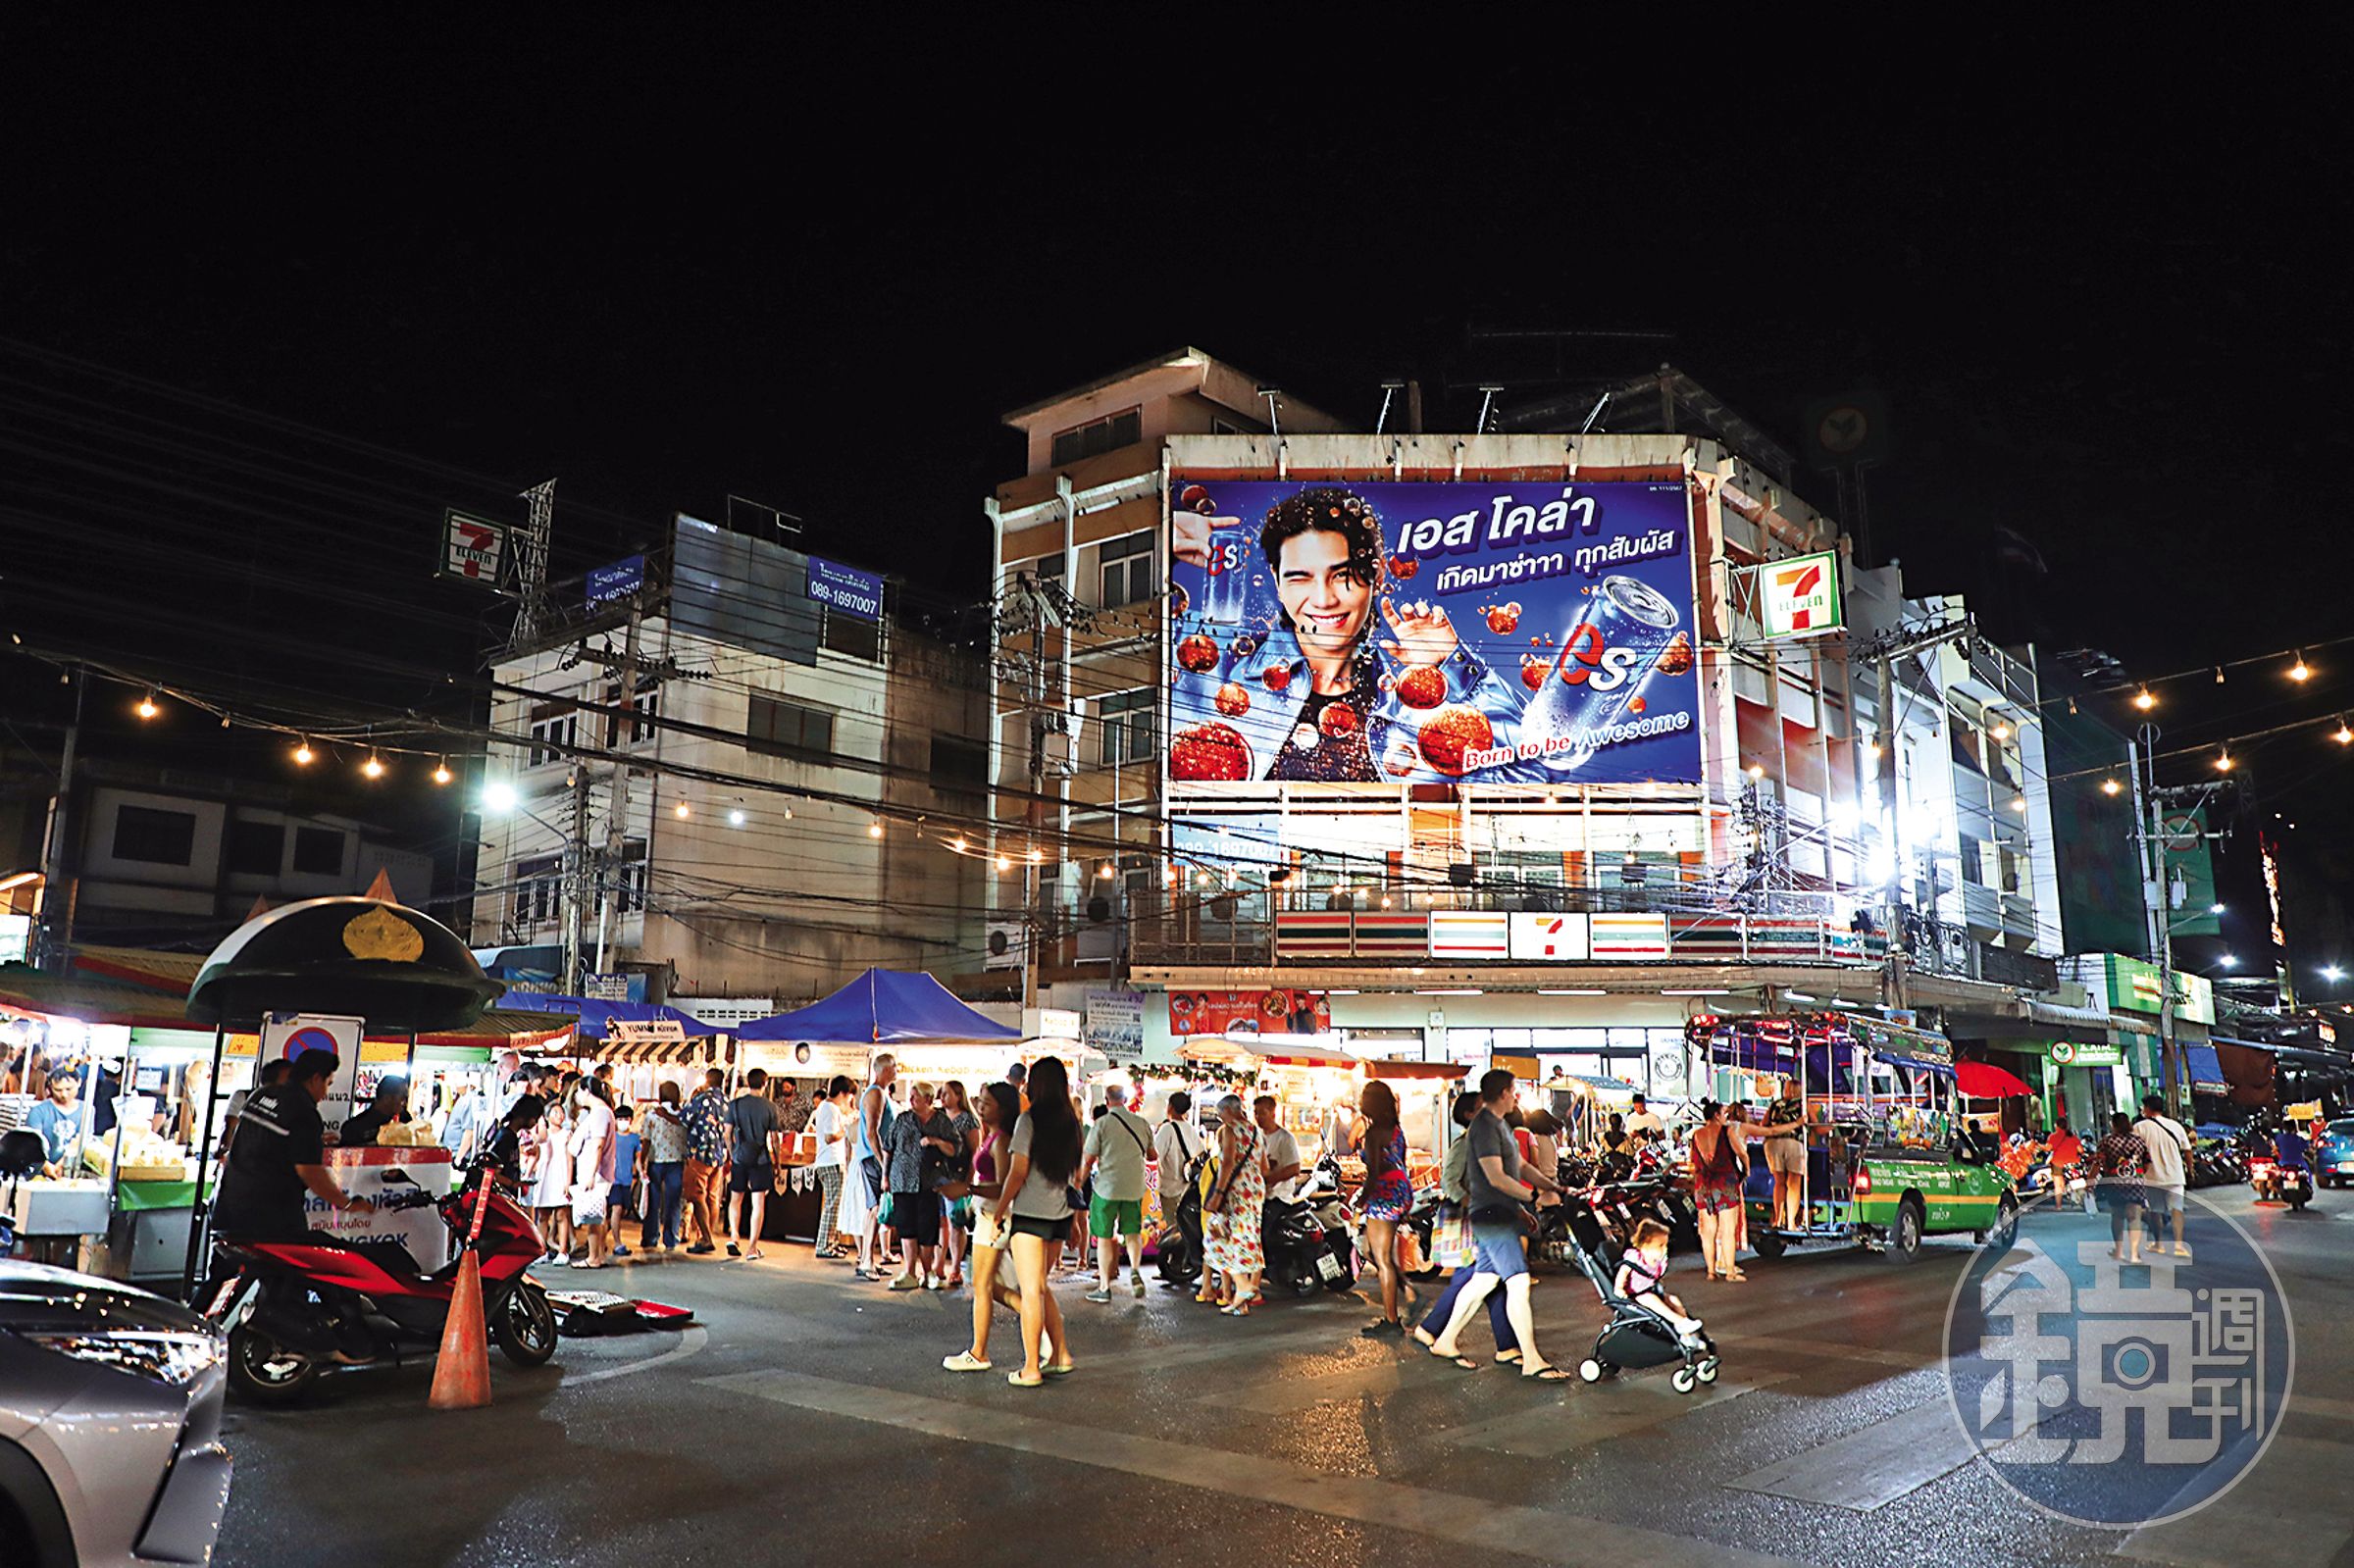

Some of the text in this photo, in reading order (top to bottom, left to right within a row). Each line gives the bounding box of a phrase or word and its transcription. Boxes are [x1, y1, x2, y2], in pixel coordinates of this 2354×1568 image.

[1397, 487, 1595, 554] เอส โคล่า
[459, 523, 493, 579] 7
[1437, 530, 1675, 590] เกิดมาซ่าาา ทุกสัมผัส
[811, 581, 878, 615] 089-1697007
[1776, 565, 1820, 630] 7
[1464, 712, 1689, 770] Born to be Awesome
[1535, 917, 1563, 955] 7
